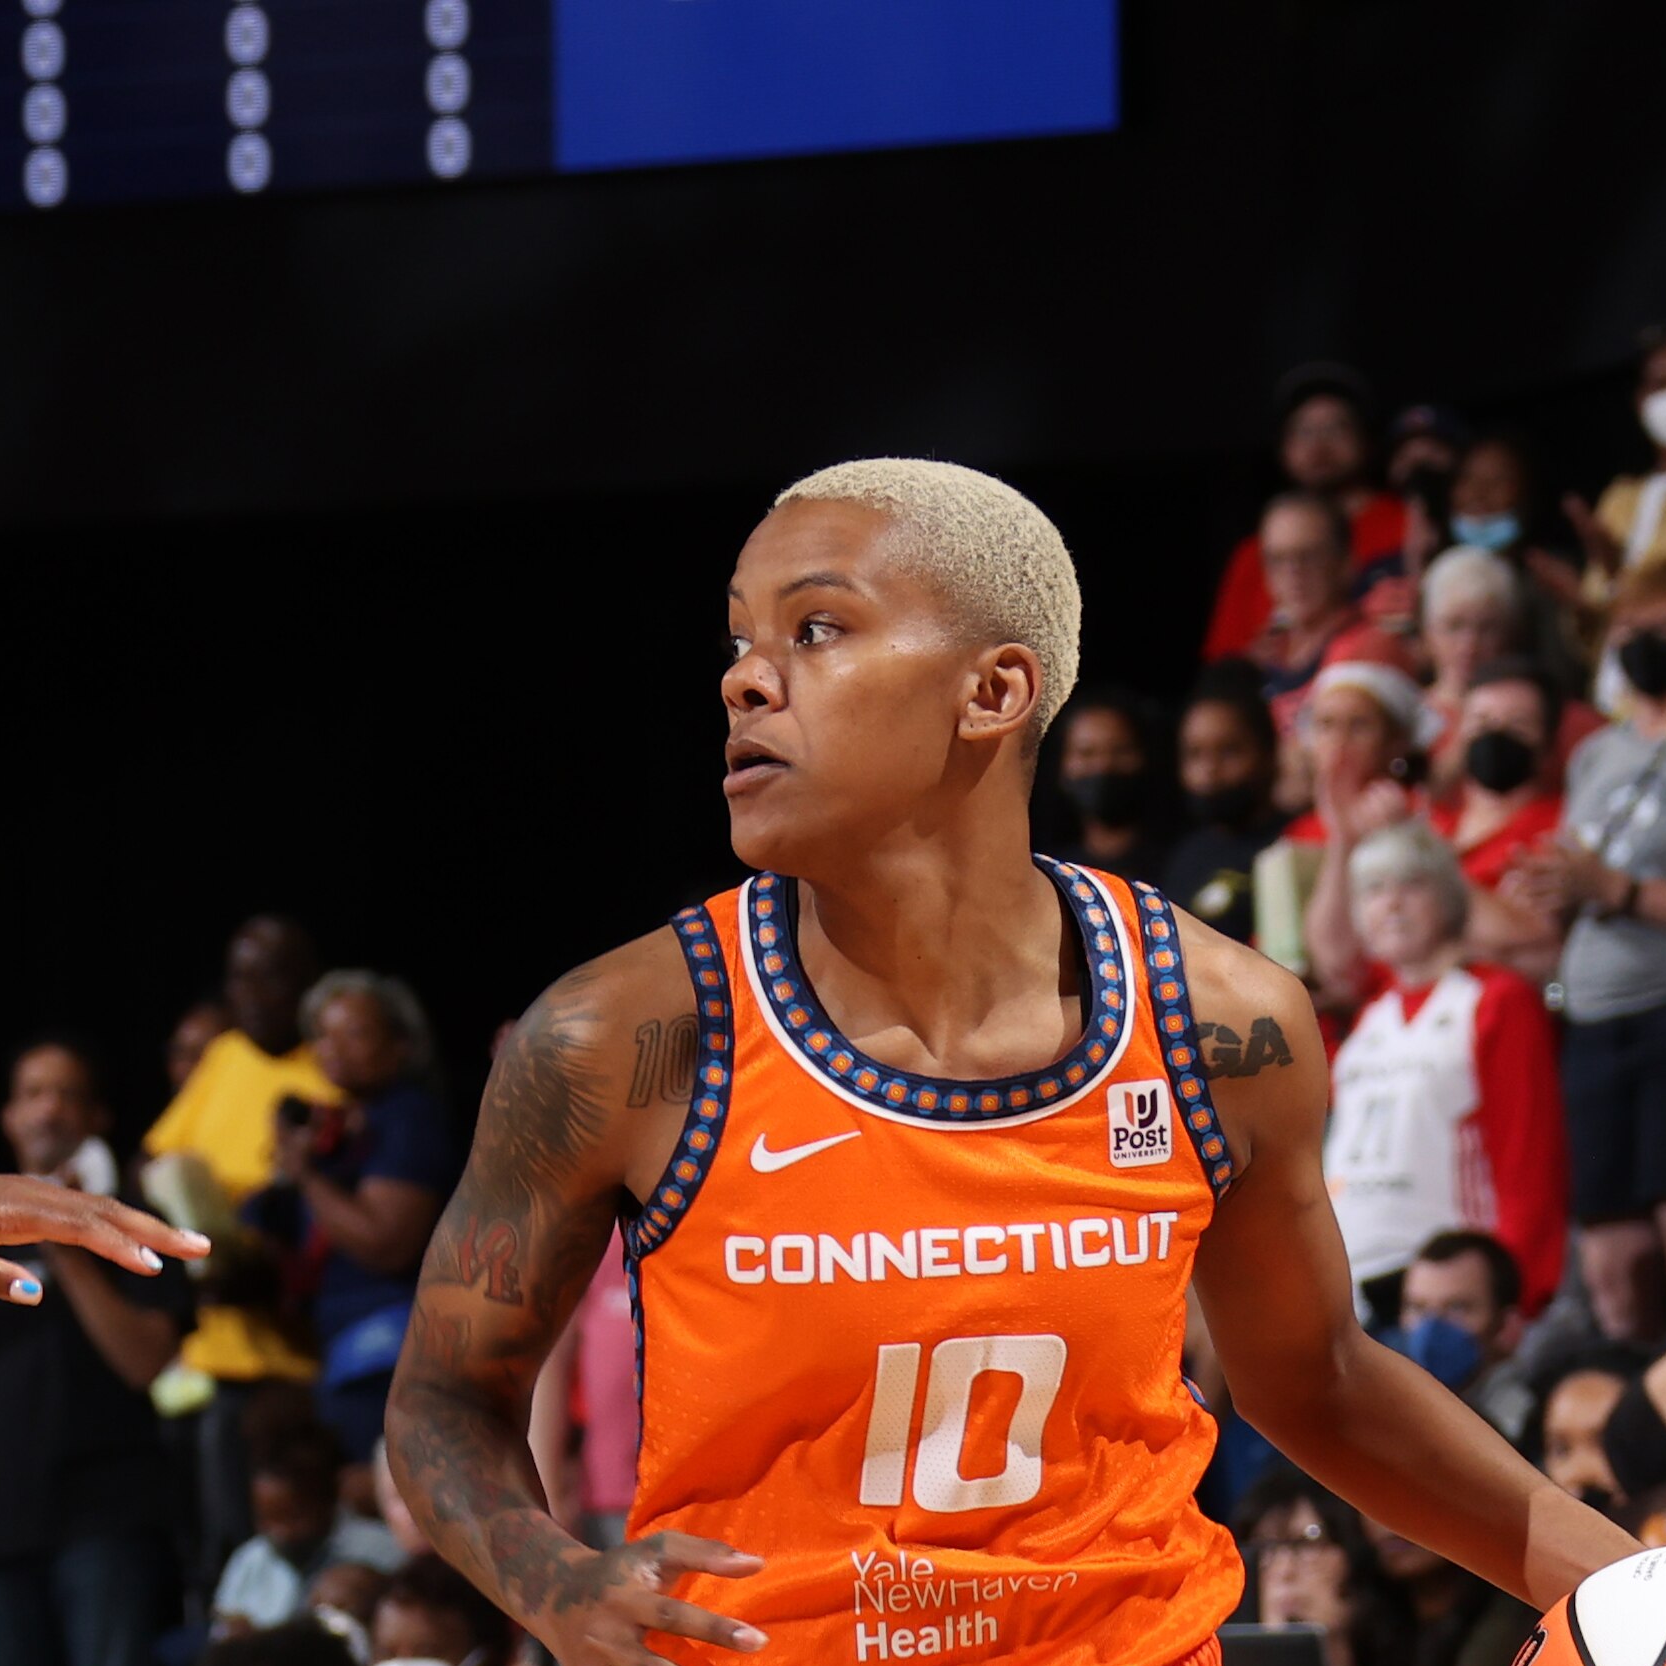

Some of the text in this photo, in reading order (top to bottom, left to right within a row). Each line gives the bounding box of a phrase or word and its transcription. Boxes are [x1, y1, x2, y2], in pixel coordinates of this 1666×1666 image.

[1113, 1124, 1168, 1151] Post
[724, 1211, 1179, 1284] CONNECTICUT
[859, 1333, 1068, 1513] 10
[850, 1550, 935, 1583] Yale
[855, 1610, 999, 1663] Health
